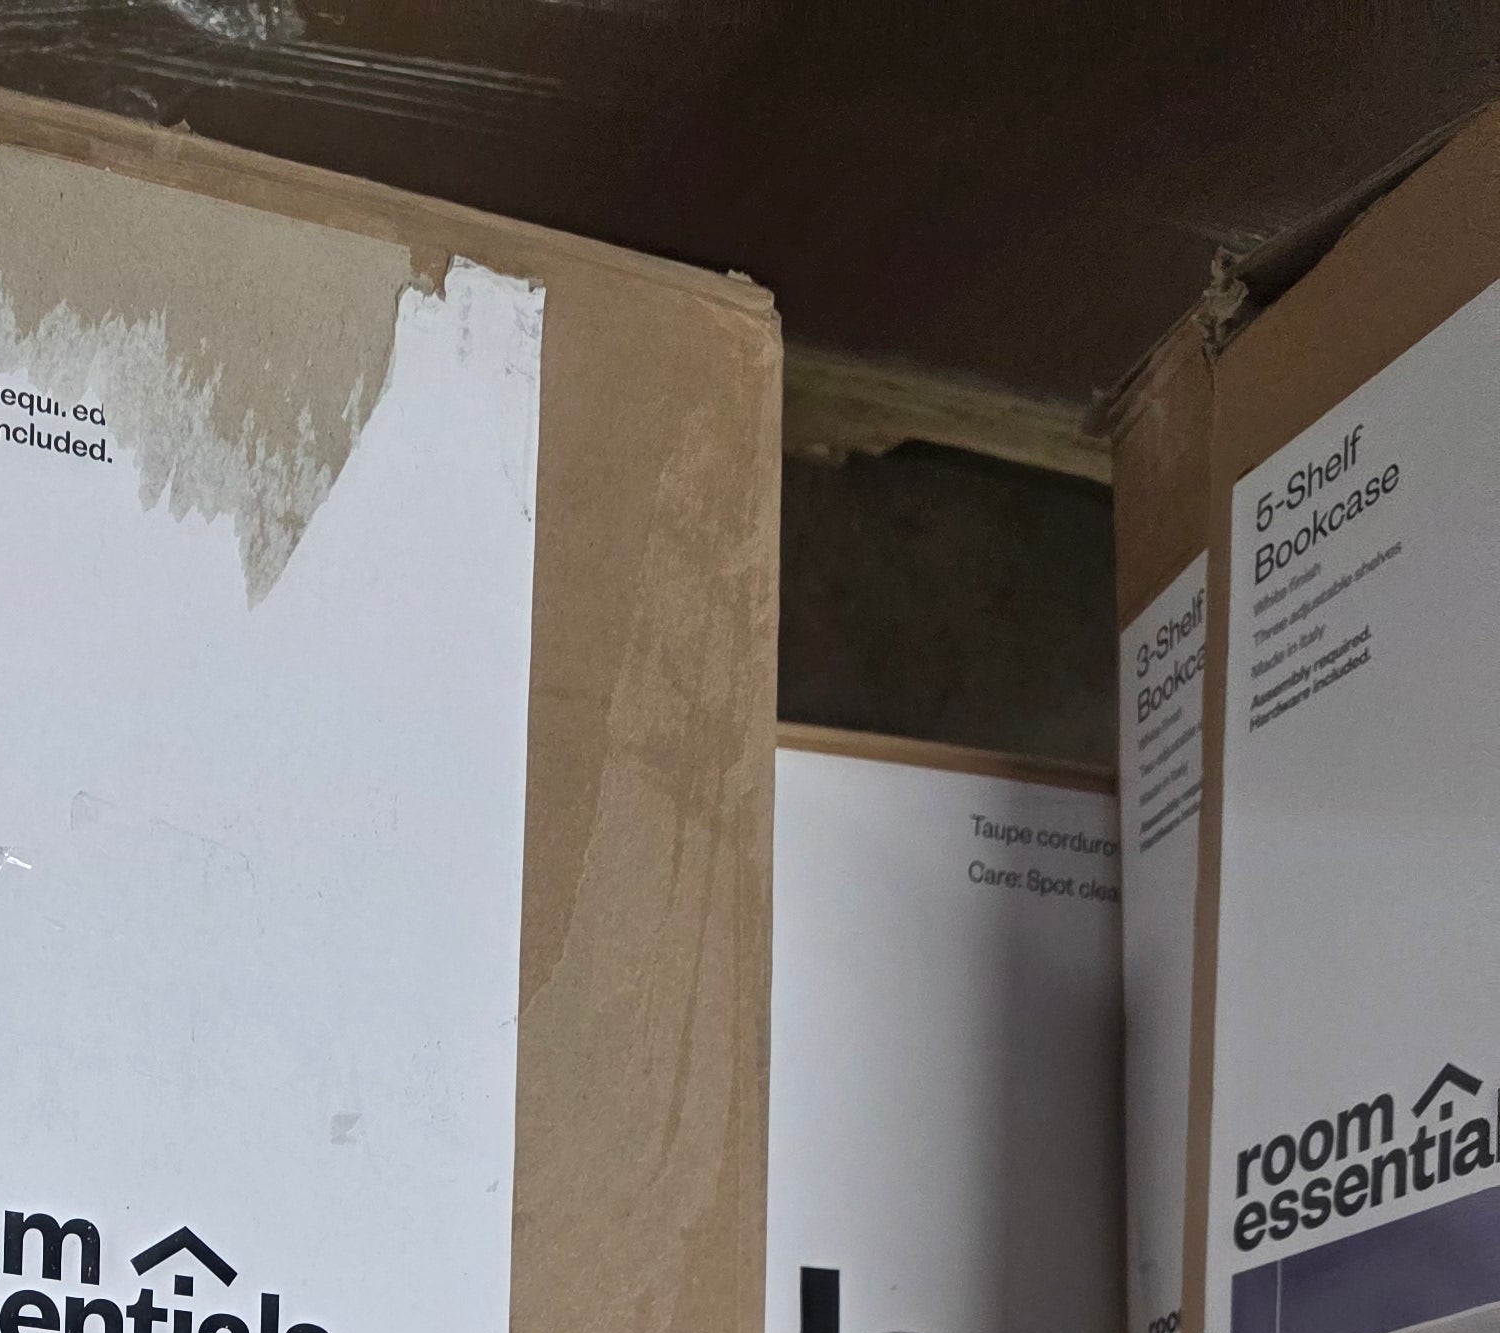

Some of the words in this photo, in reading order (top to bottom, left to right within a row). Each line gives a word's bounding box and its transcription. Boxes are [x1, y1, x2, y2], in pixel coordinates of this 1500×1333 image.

[1255, 463, 1400, 586] Bookcase
[1256, 423, 1364, 532] 5-Shelf
[1137, 588, 1204, 678] 3-Shelf
[968, 859, 1023, 889] Care:
[1026, 868, 1074, 897] Spot
[970, 813, 1032, 846] Taupe
[1233, 1087, 1500, 1252] essentia
[1236, 1093, 1394, 1199] room
